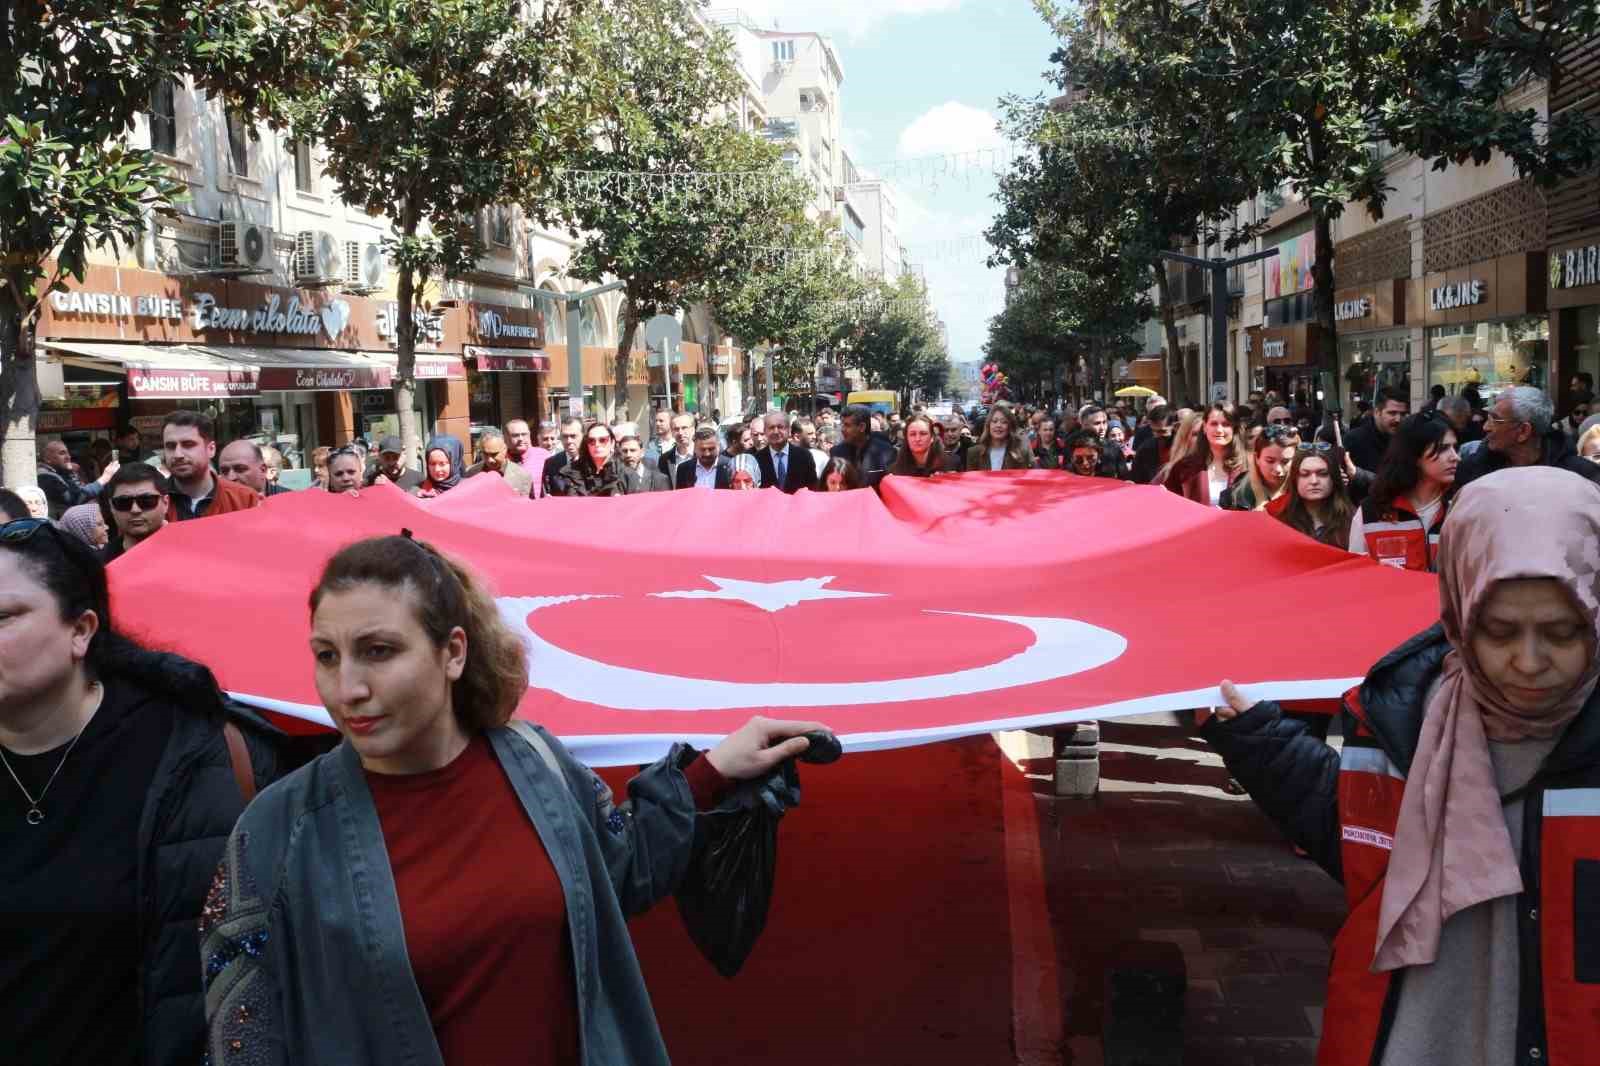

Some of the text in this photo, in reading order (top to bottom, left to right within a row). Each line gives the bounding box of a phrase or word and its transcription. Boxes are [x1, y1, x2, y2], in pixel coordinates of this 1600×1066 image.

[1565, 245, 1600, 288] BAR
[137, 293, 182, 319] BÜFE
[181, 373, 209, 391] BÜFE
